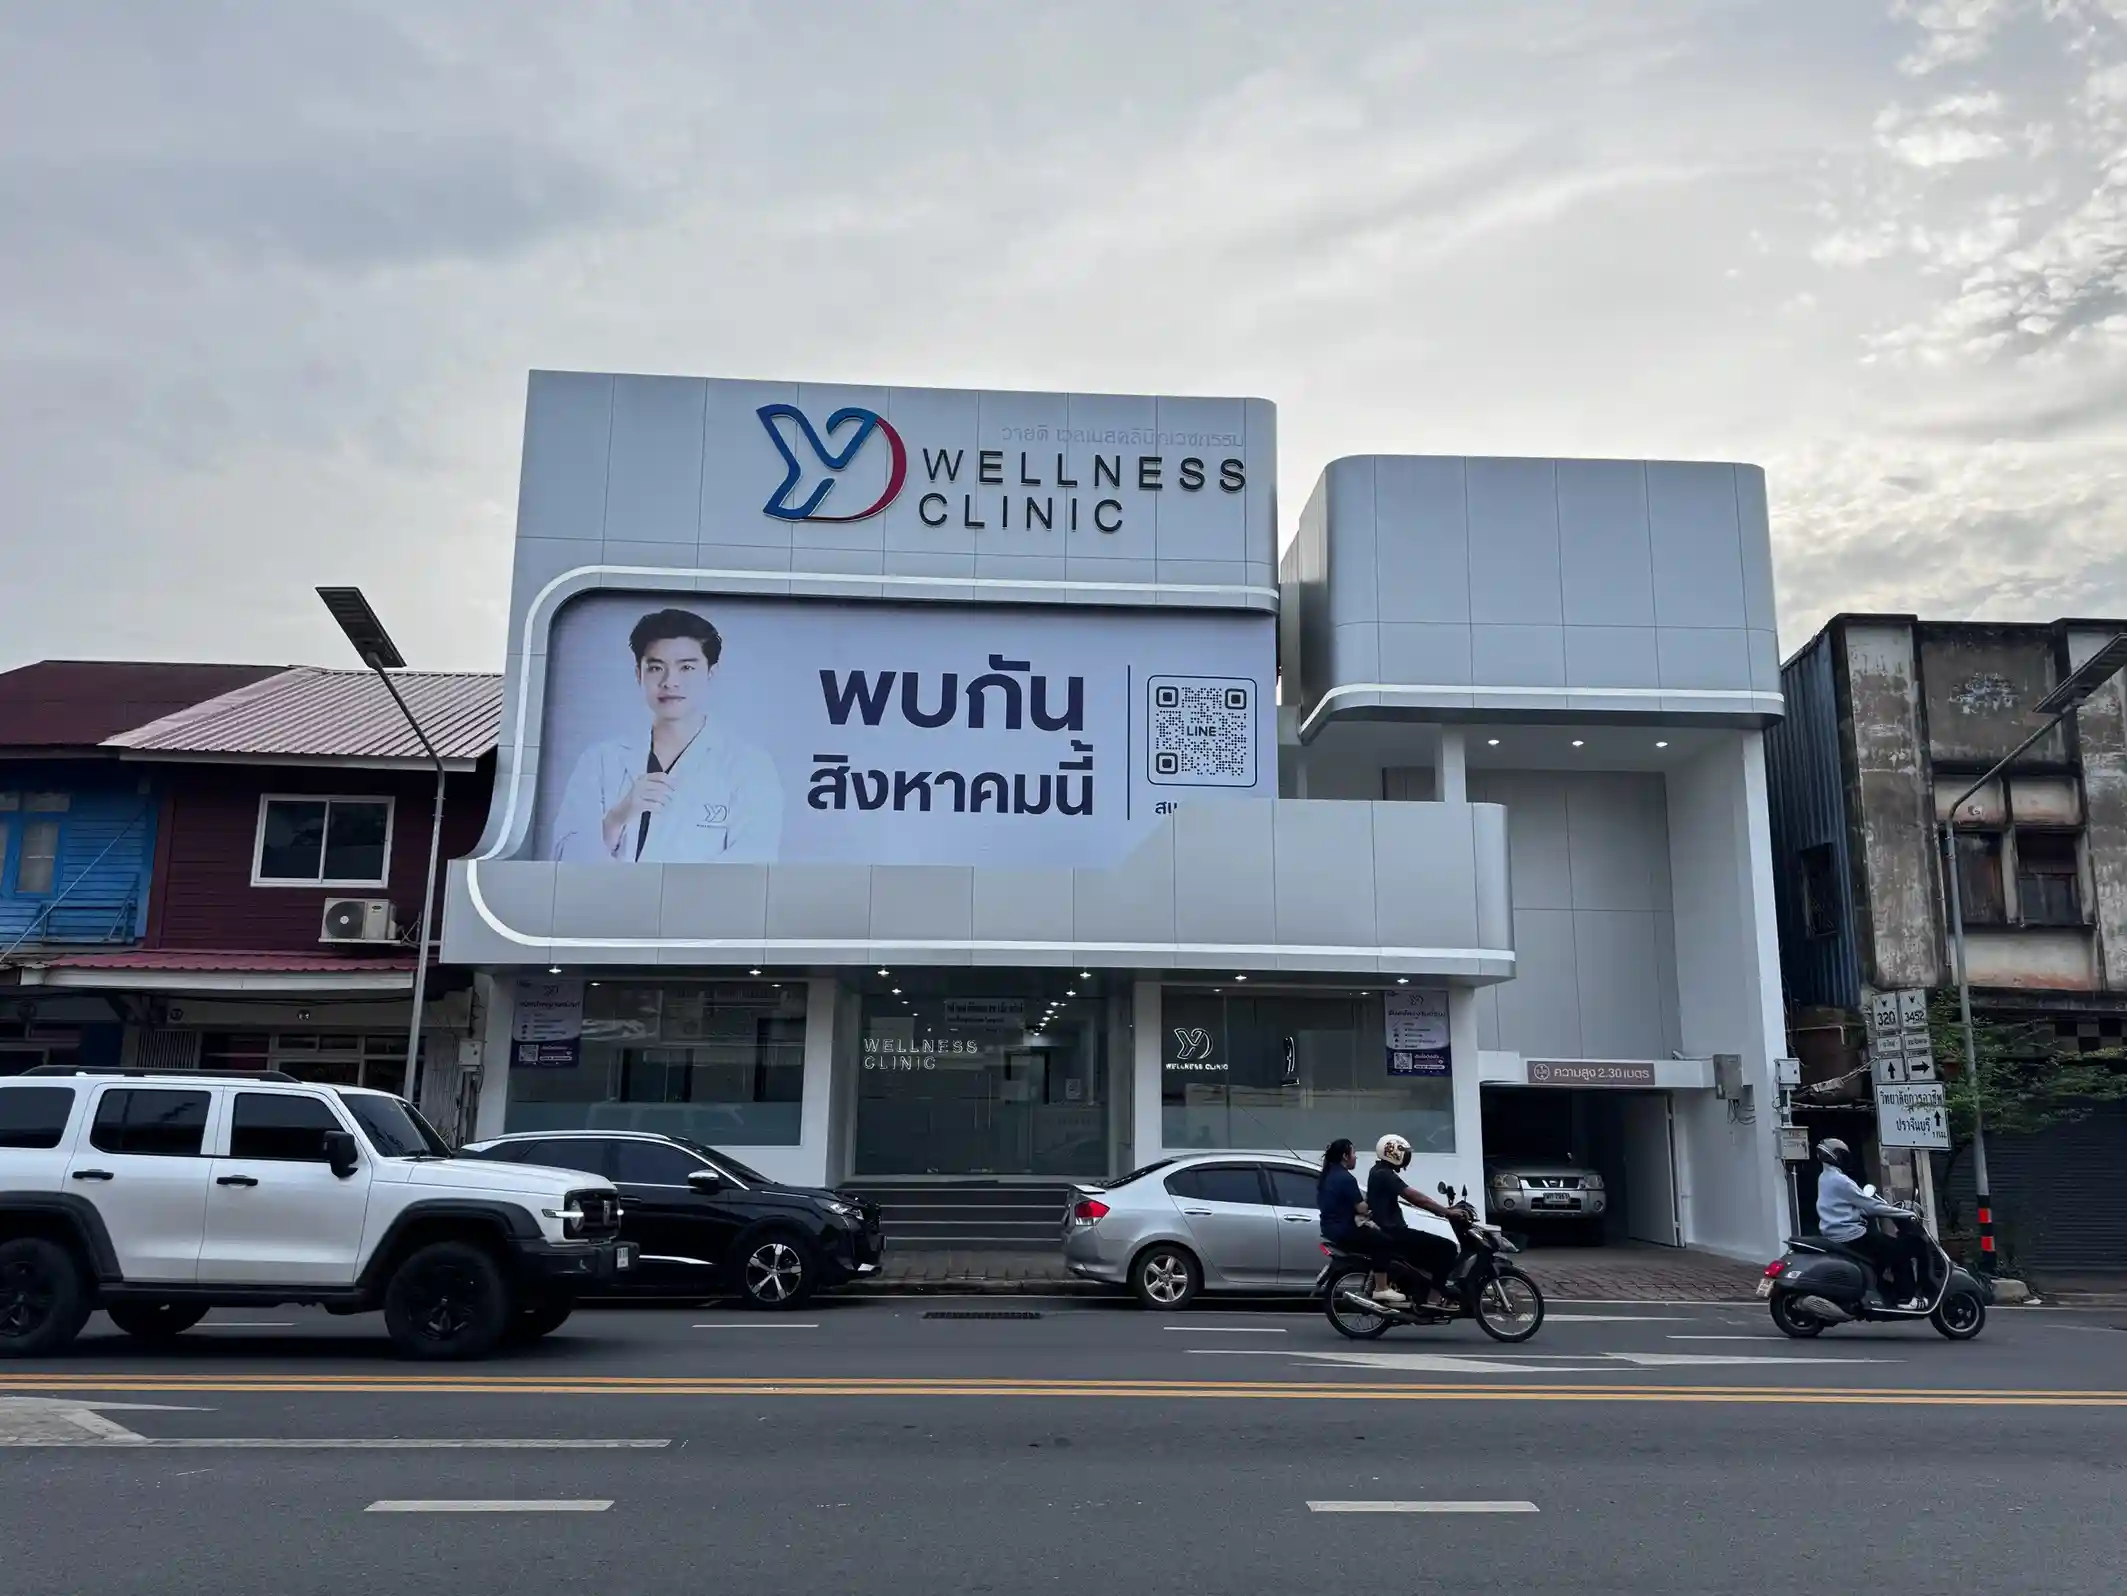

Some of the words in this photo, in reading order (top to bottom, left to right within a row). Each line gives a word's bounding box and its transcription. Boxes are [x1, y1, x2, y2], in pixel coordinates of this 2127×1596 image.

[922, 447, 1246, 492] WELLNESS
[918, 492, 1123, 533] CLINIC
[818, 653, 1084, 731] พบกัน
[1186, 725, 1217, 737] LINE
[806, 739, 1094, 816] สิงหาคมนี้
[1877, 1011, 1896, 1026] 320
[863, 1038, 978, 1054] WELLNESS
[863, 1055, 937, 1071] CLINIC
[1165, 1062, 1203, 1071] WELLNESS
[1204, 1063, 1229, 1071] CLINIC
[1554, 1067, 1596, 1080] ความสูง
[1599, 1068, 1622, 1079] 2.30
